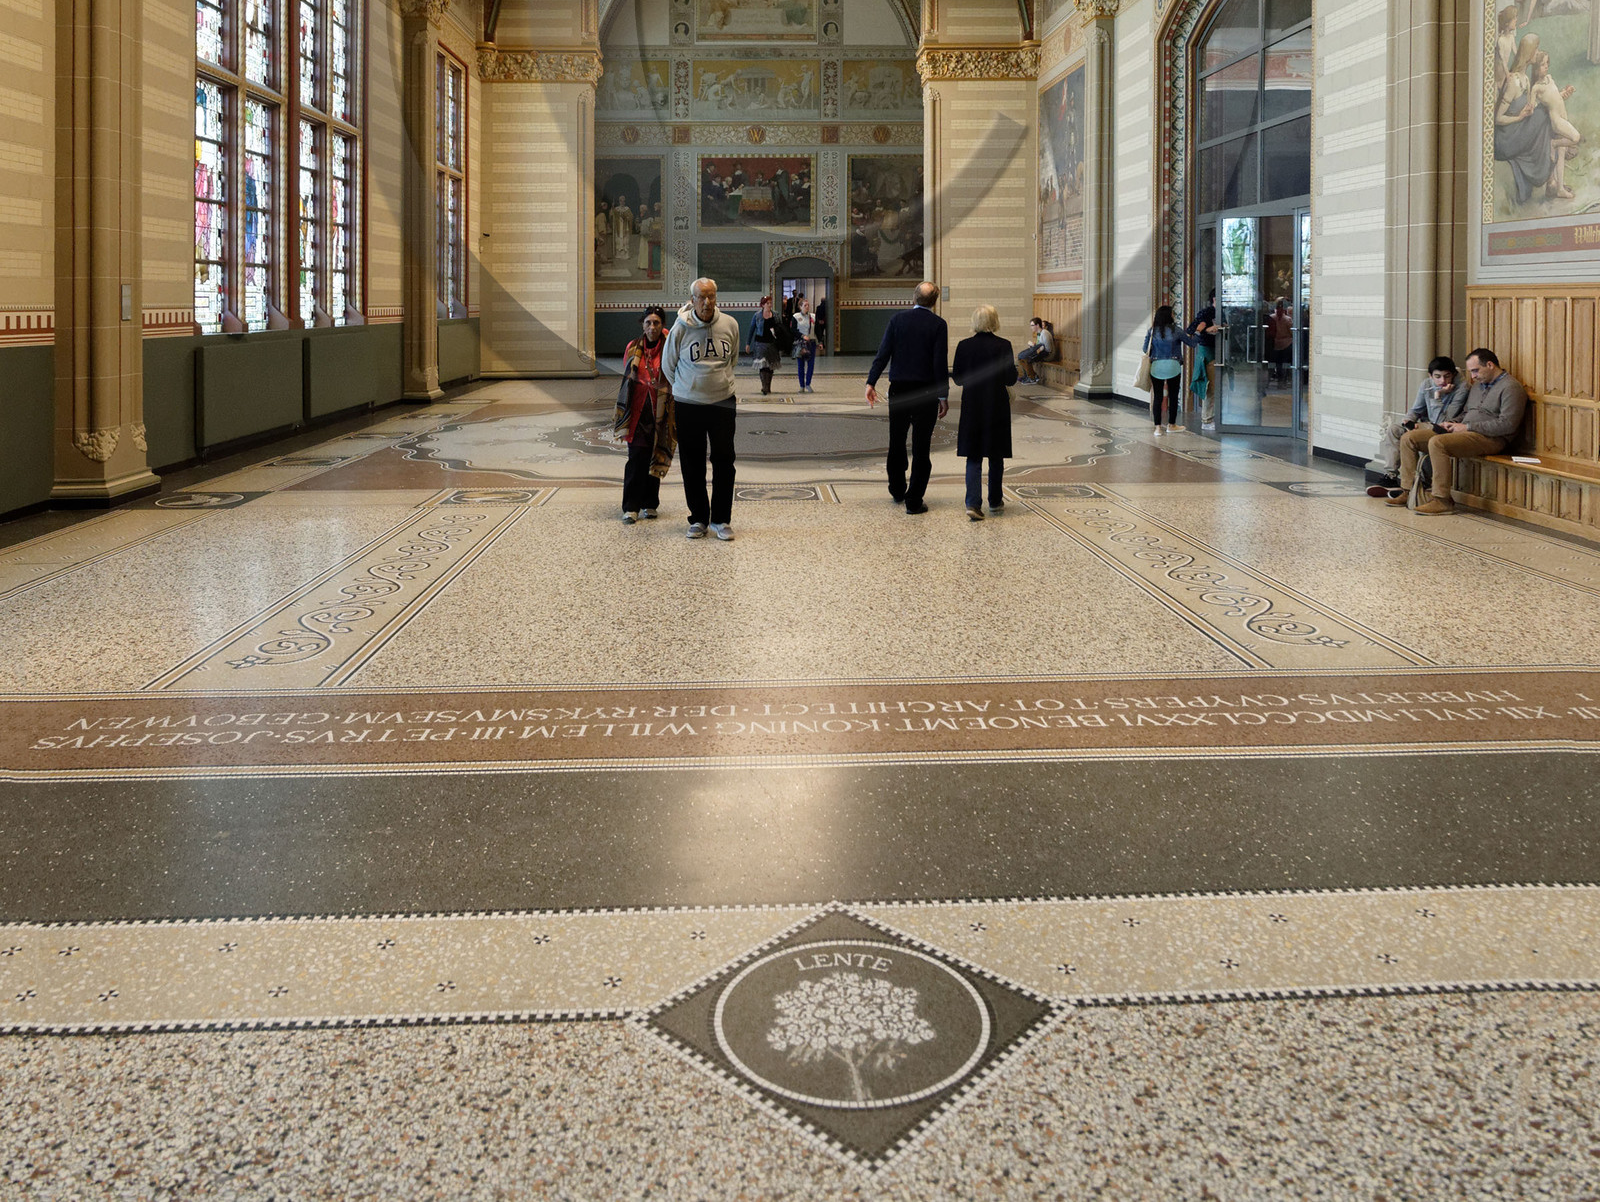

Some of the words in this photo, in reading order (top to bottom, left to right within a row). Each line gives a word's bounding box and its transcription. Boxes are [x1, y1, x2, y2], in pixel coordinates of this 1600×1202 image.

[689, 338, 731, 362] GAP
[1008, 697, 1096, 712] TOT
[1102, 694, 1289, 709] CVYPERS
[1298, 690, 1523, 705] HVBERTVS
[647, 704, 735, 718] DER
[751, 699, 991, 714] ARCHITECT
[63, 712, 330, 730] GEBOVWEN
[895, 713, 1106, 731] BENOEMT
[1115, 708, 1393, 726] MDCCCLXXVI
[471, 726, 505, 740] III
[518, 722, 697, 739] WILLEM
[716, 718, 878, 734] KONING
[31, 730, 271, 749] JOSEPHVS
[278, 727, 456, 744] PETRVS
[794, 952, 893, 973] LENTE
